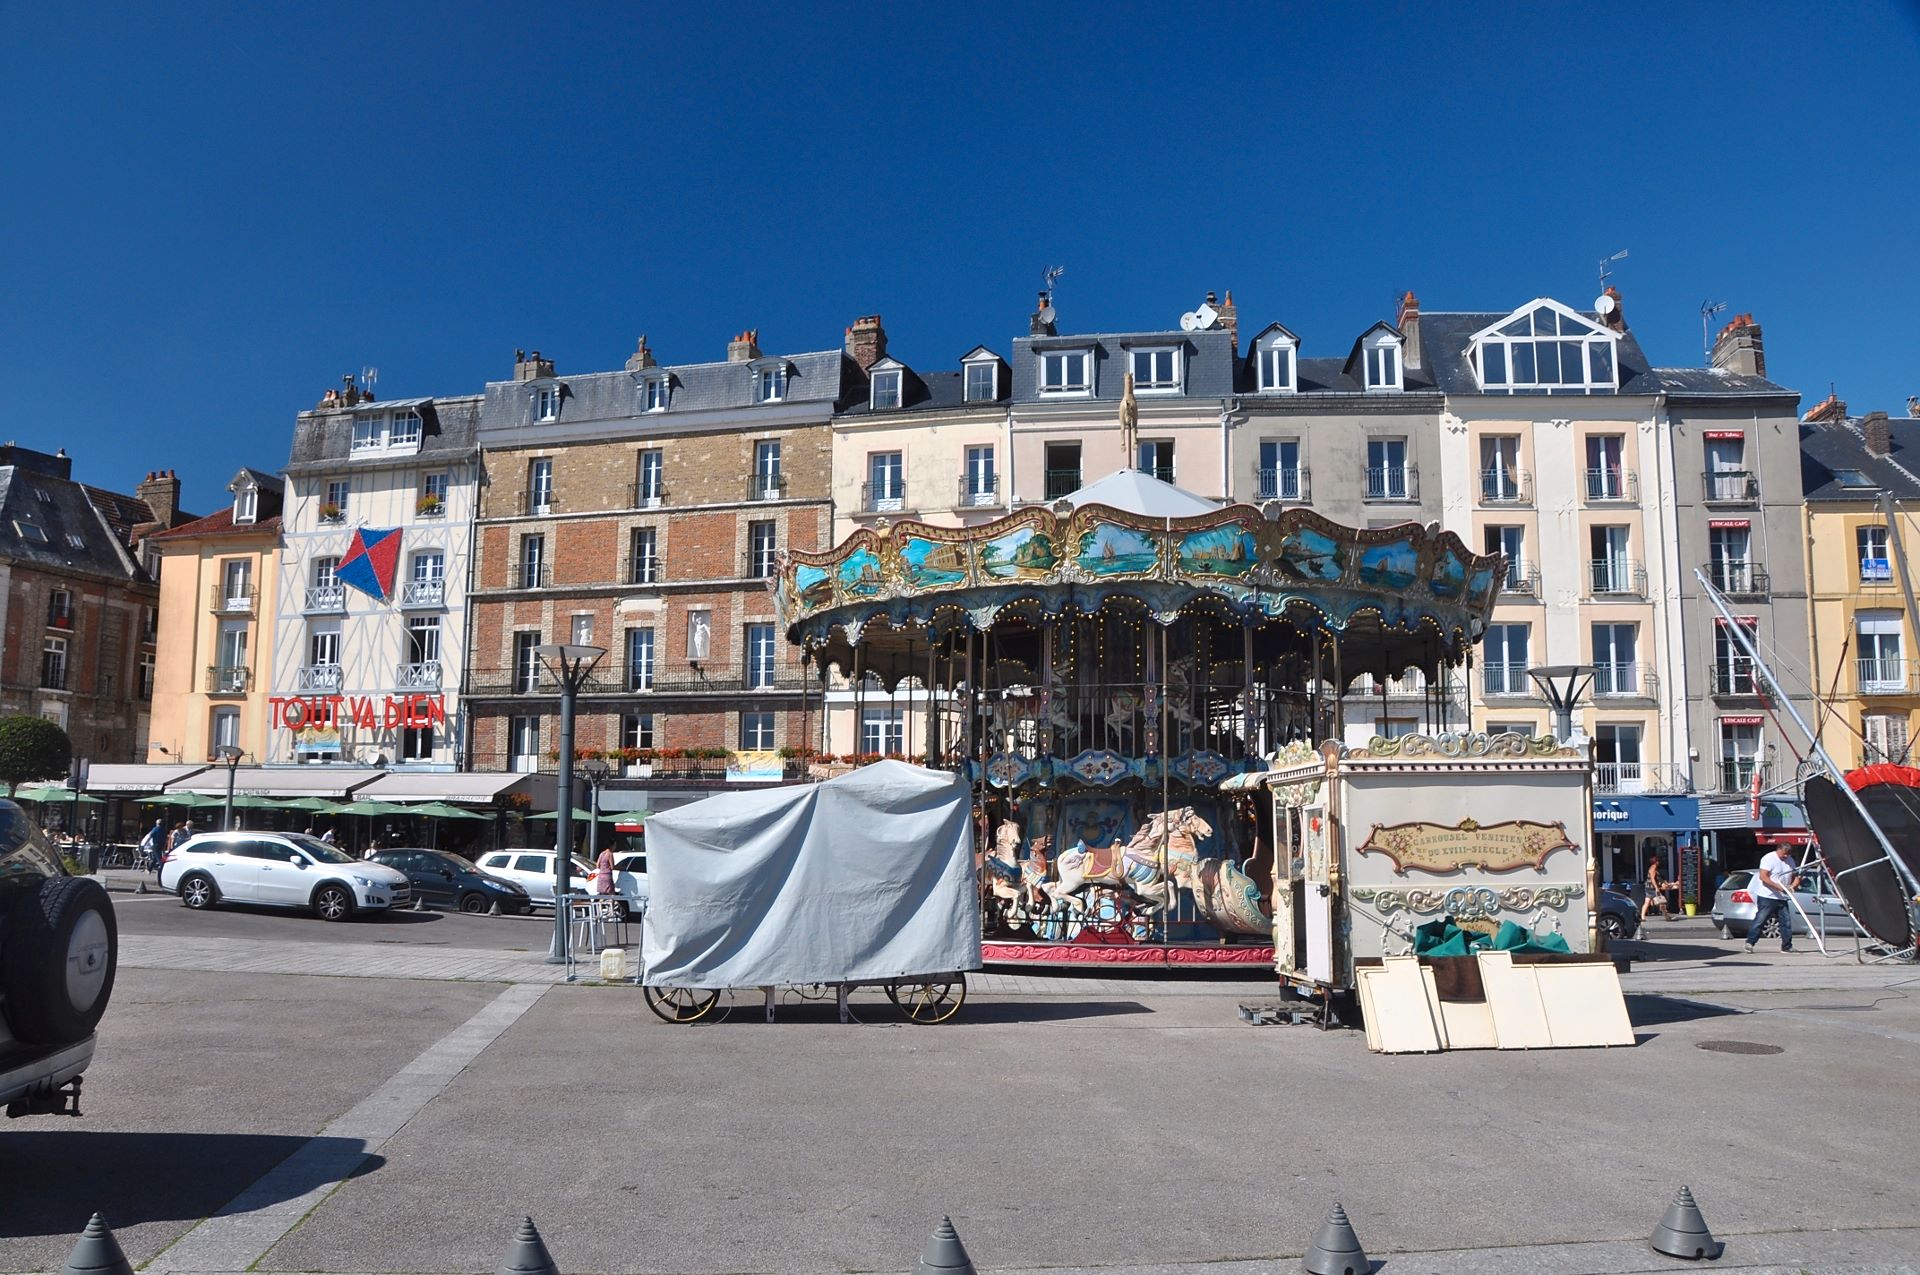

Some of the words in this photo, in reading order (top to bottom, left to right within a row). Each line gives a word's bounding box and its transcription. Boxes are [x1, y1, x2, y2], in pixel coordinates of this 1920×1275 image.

[269, 695, 345, 732] TOUT
[350, 696, 377, 729] VA
[384, 694, 446, 730] BIEN
[1413, 833, 1468, 846] CARROUSEL
[1428, 848, 1440, 857] DU
